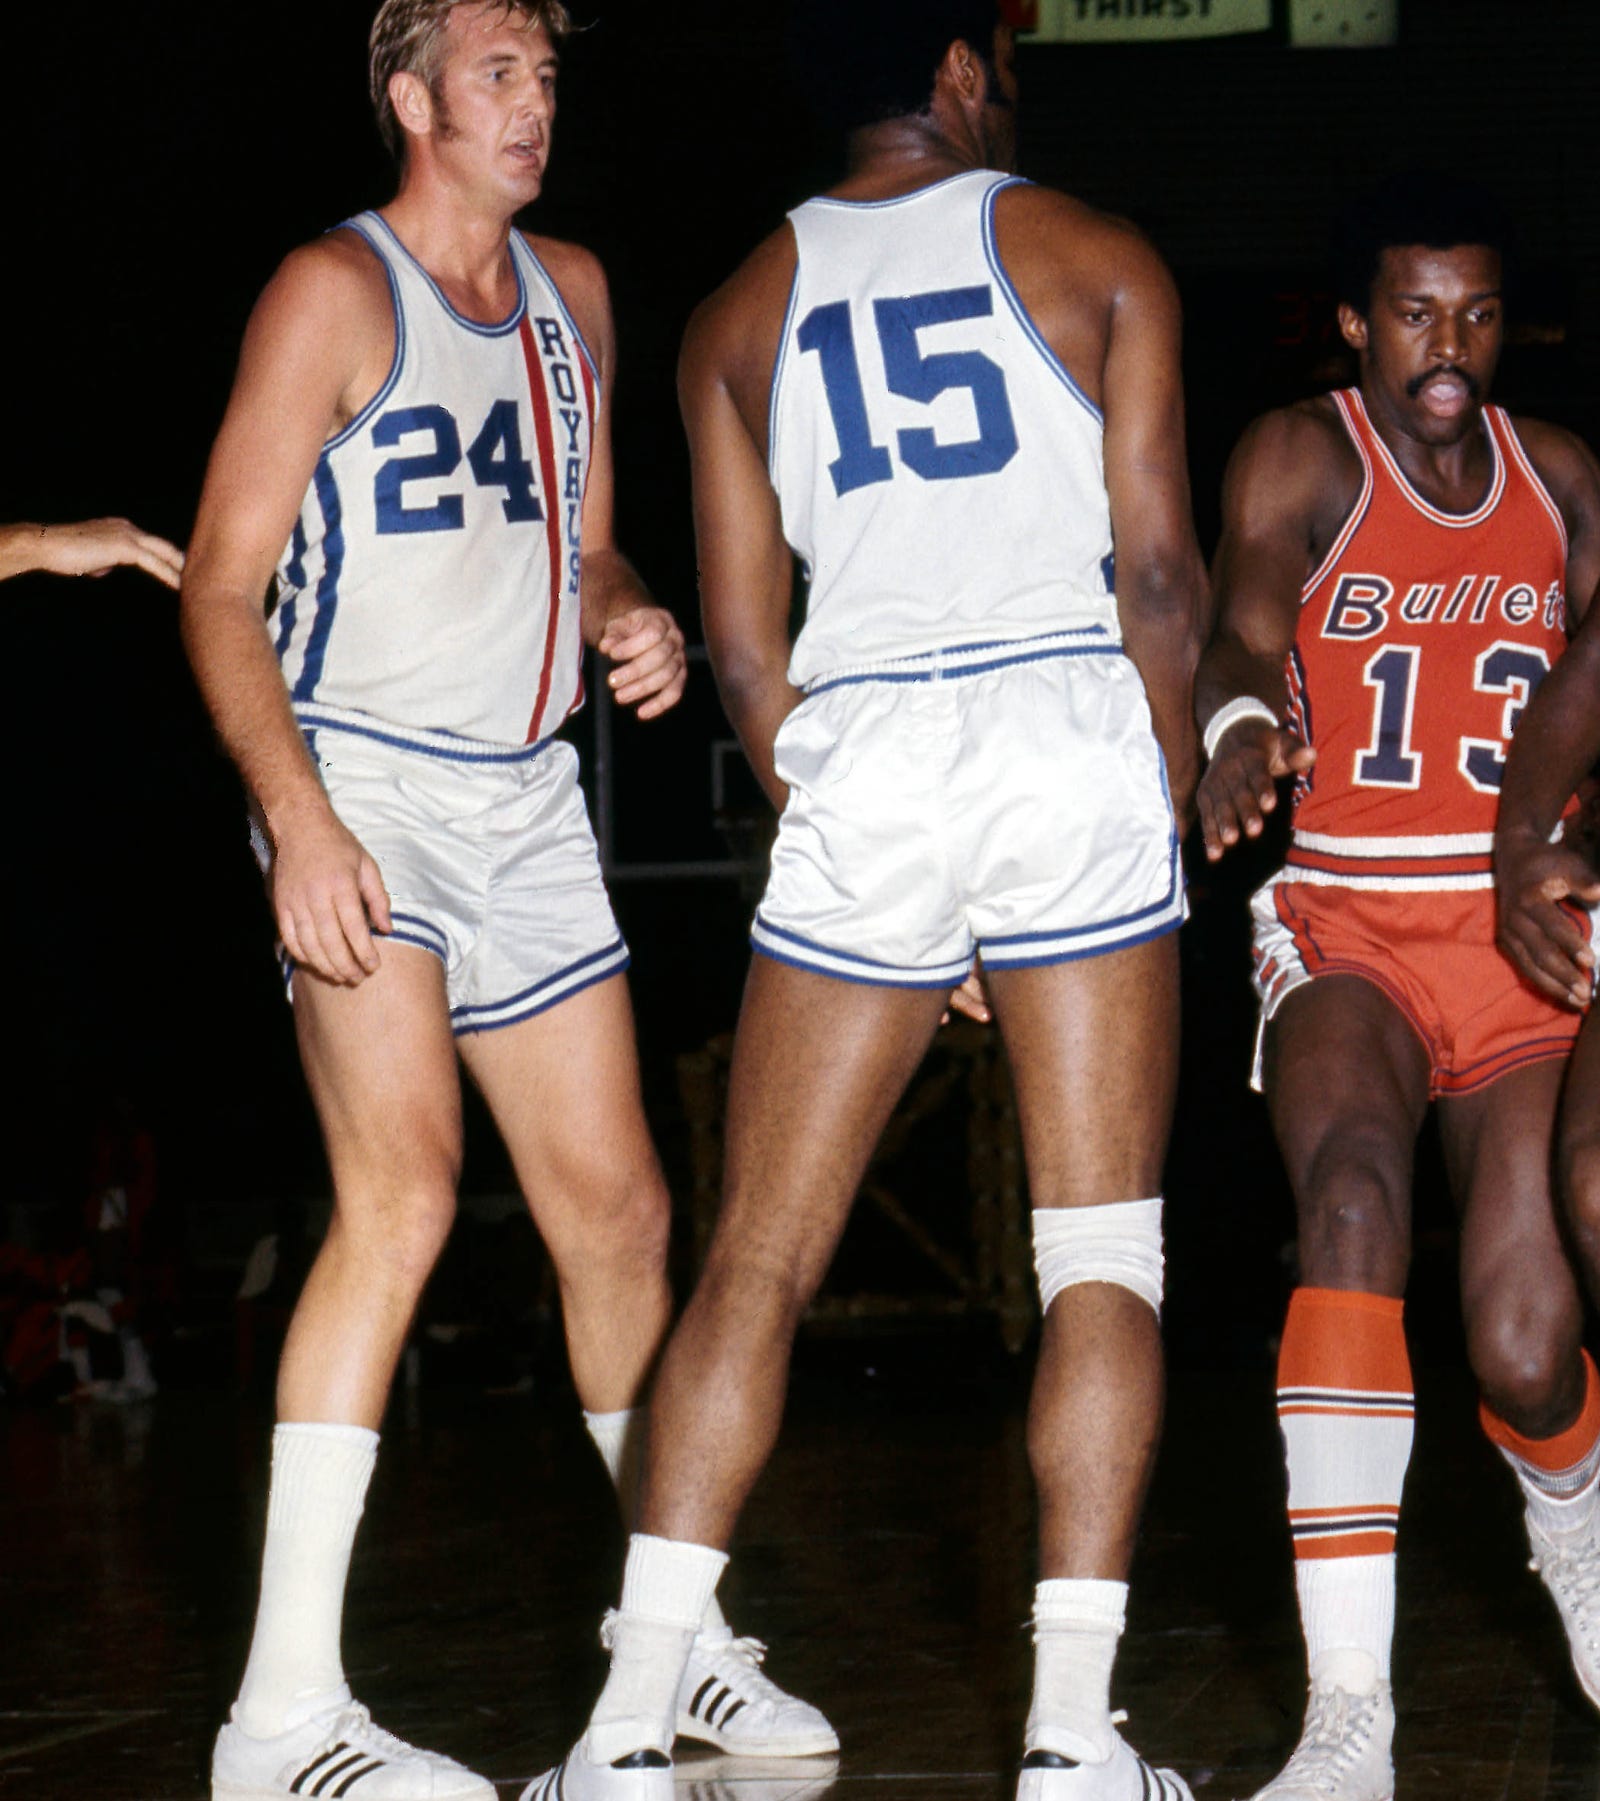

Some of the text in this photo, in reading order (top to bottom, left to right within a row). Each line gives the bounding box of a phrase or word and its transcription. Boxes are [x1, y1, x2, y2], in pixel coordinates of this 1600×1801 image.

[371, 398, 546, 535] 24
[535, 316, 582, 595] ROYALS
[796, 283, 1020, 498] 15
[1352, 639, 1551, 795] 13
